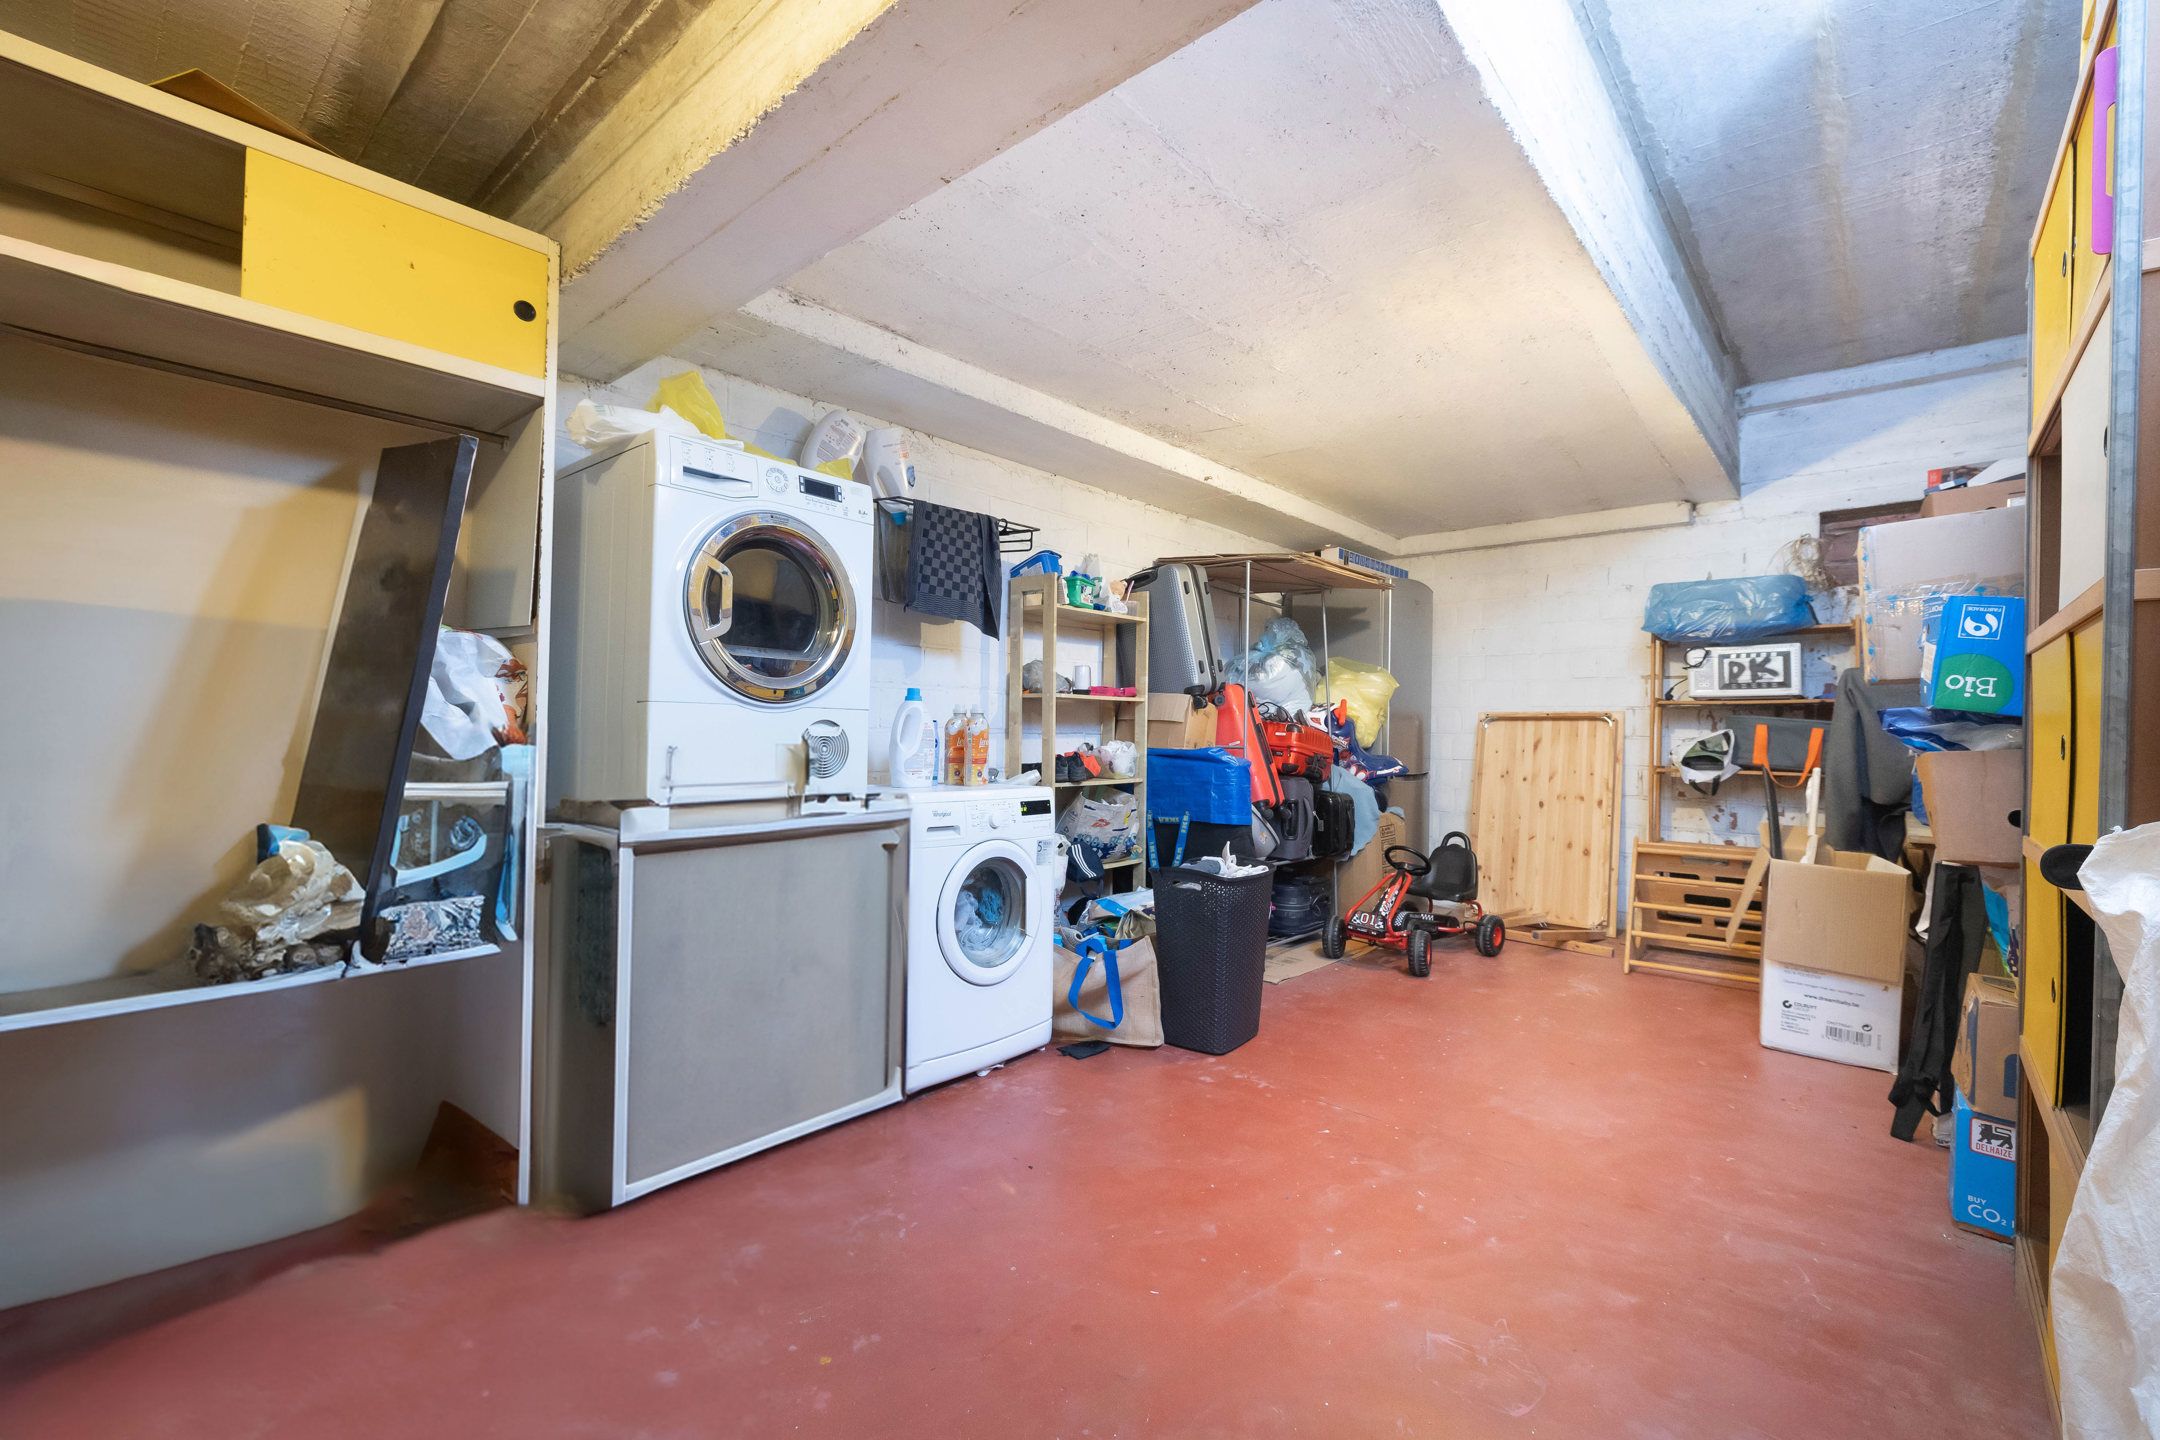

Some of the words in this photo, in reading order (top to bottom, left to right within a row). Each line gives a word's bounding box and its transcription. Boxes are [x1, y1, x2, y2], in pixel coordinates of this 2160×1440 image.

[1945, 674, 1998, 697] Bio
[932, 810, 952, 818] Whirlpool
[1360, 912, 1375, 926] 01
[1975, 1142, 2013, 1159] DELHAIZE
[1967, 1195, 1987, 1205] BUY
